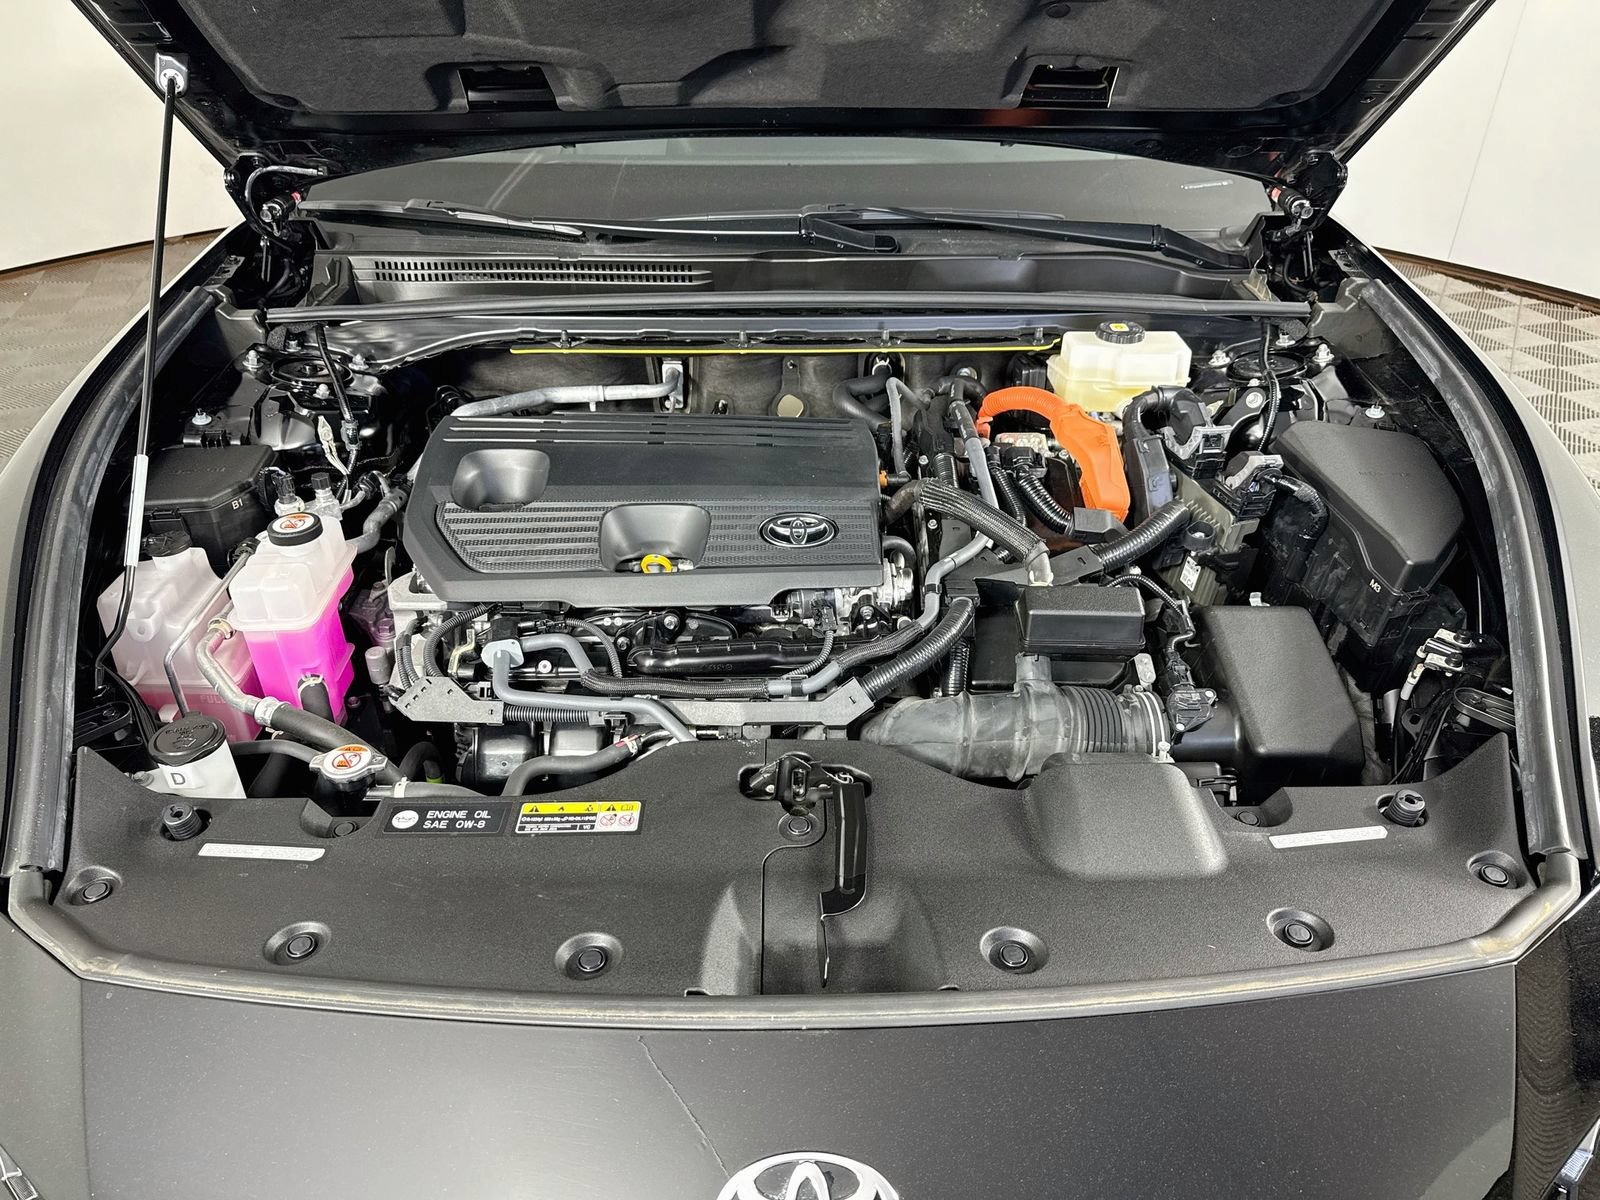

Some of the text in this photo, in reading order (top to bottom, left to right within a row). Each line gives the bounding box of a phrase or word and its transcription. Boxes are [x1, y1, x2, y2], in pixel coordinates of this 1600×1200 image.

[231, 498, 243, 510] B1
[170, 772, 186, 785] D
[426, 810, 492, 819] ENGINE OIL
[422, 820, 486, 829] SAE 0W-8
